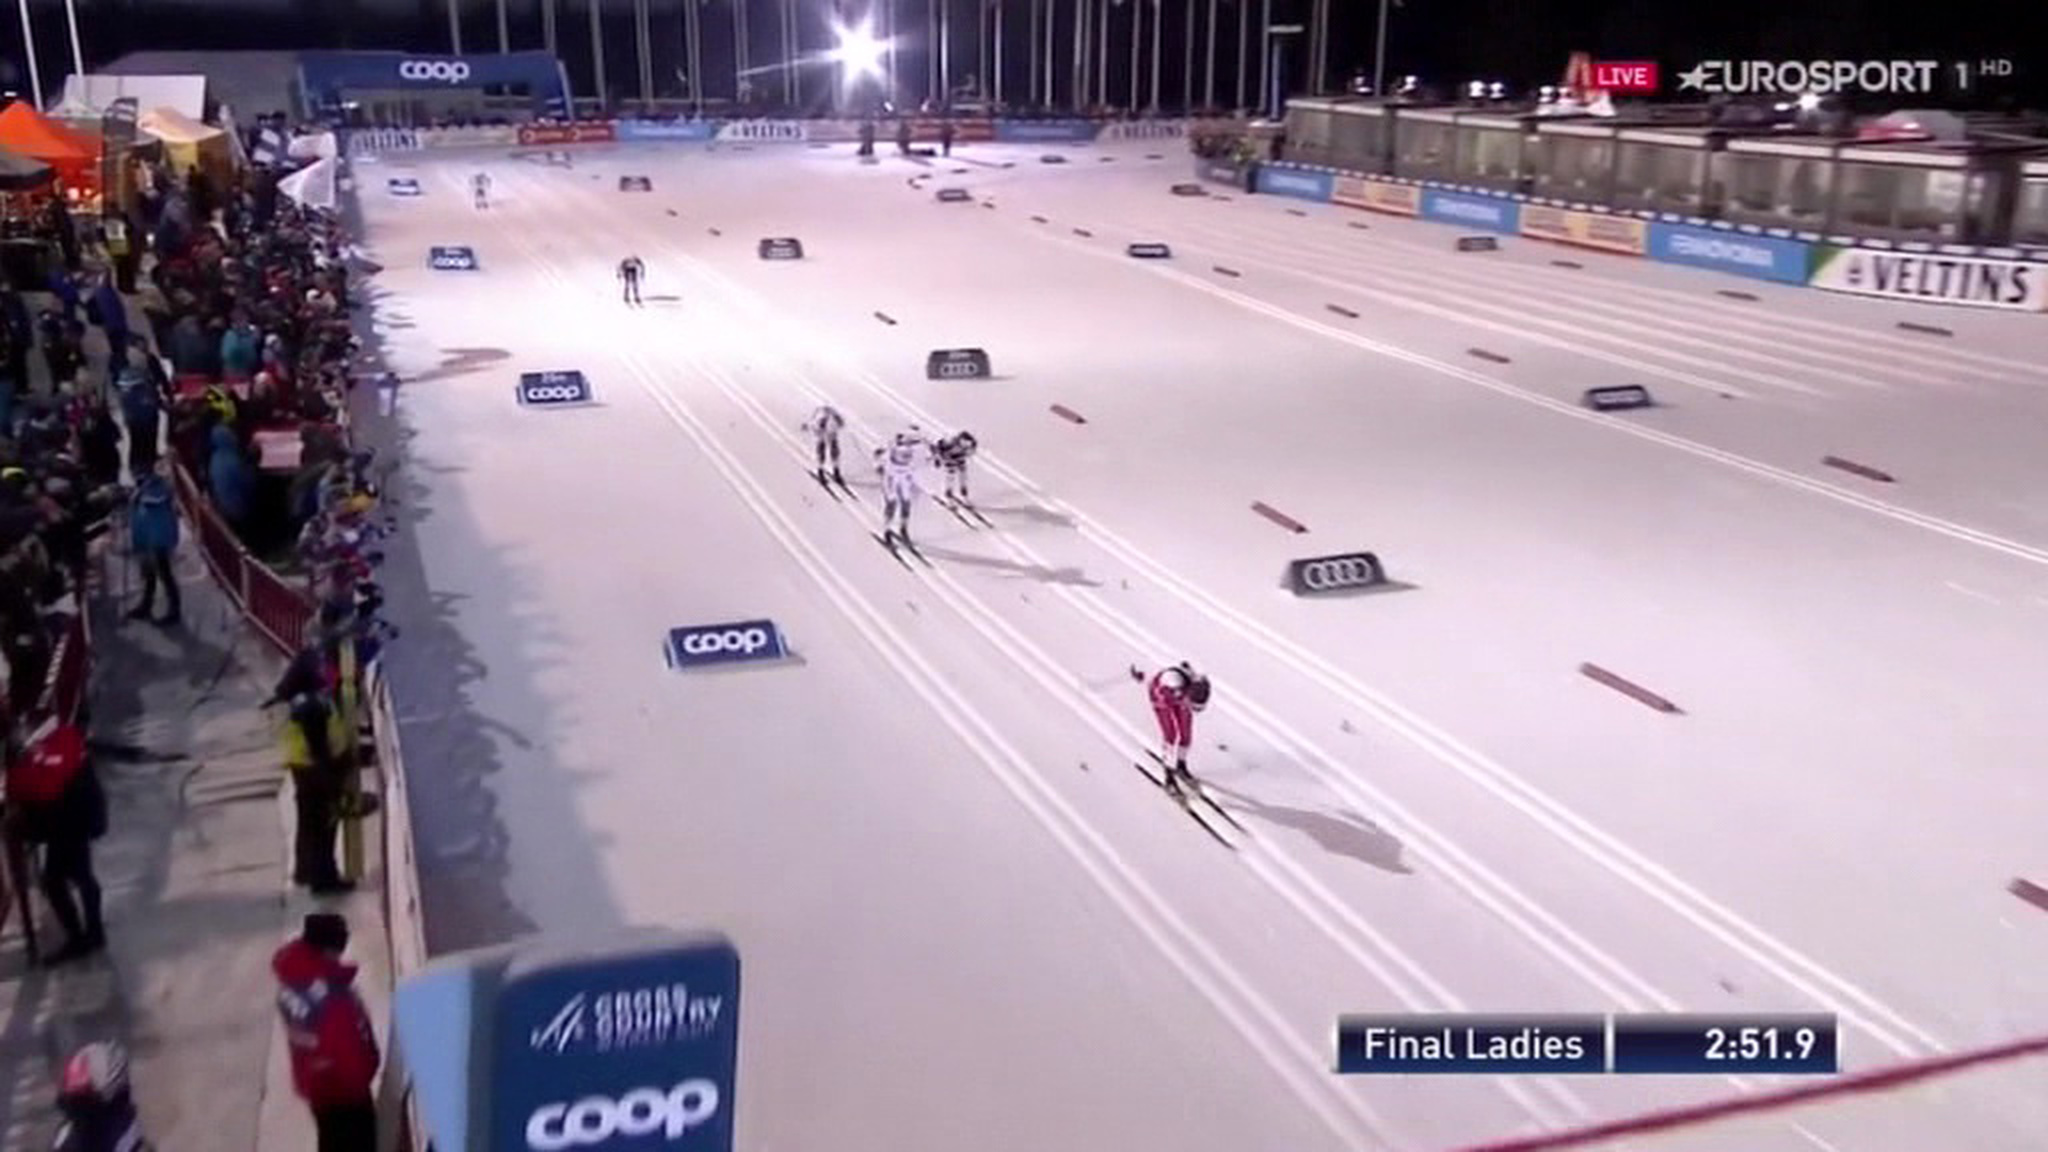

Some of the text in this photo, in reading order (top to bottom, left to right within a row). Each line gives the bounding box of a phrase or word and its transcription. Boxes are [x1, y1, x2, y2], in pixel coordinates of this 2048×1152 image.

[400, 61, 470, 84] coop
[1873, 254, 2030, 304] VELTINS
[527, 385, 580, 400] coop
[682, 628, 767, 654] coop
[525, 1078, 719, 1150] coop
